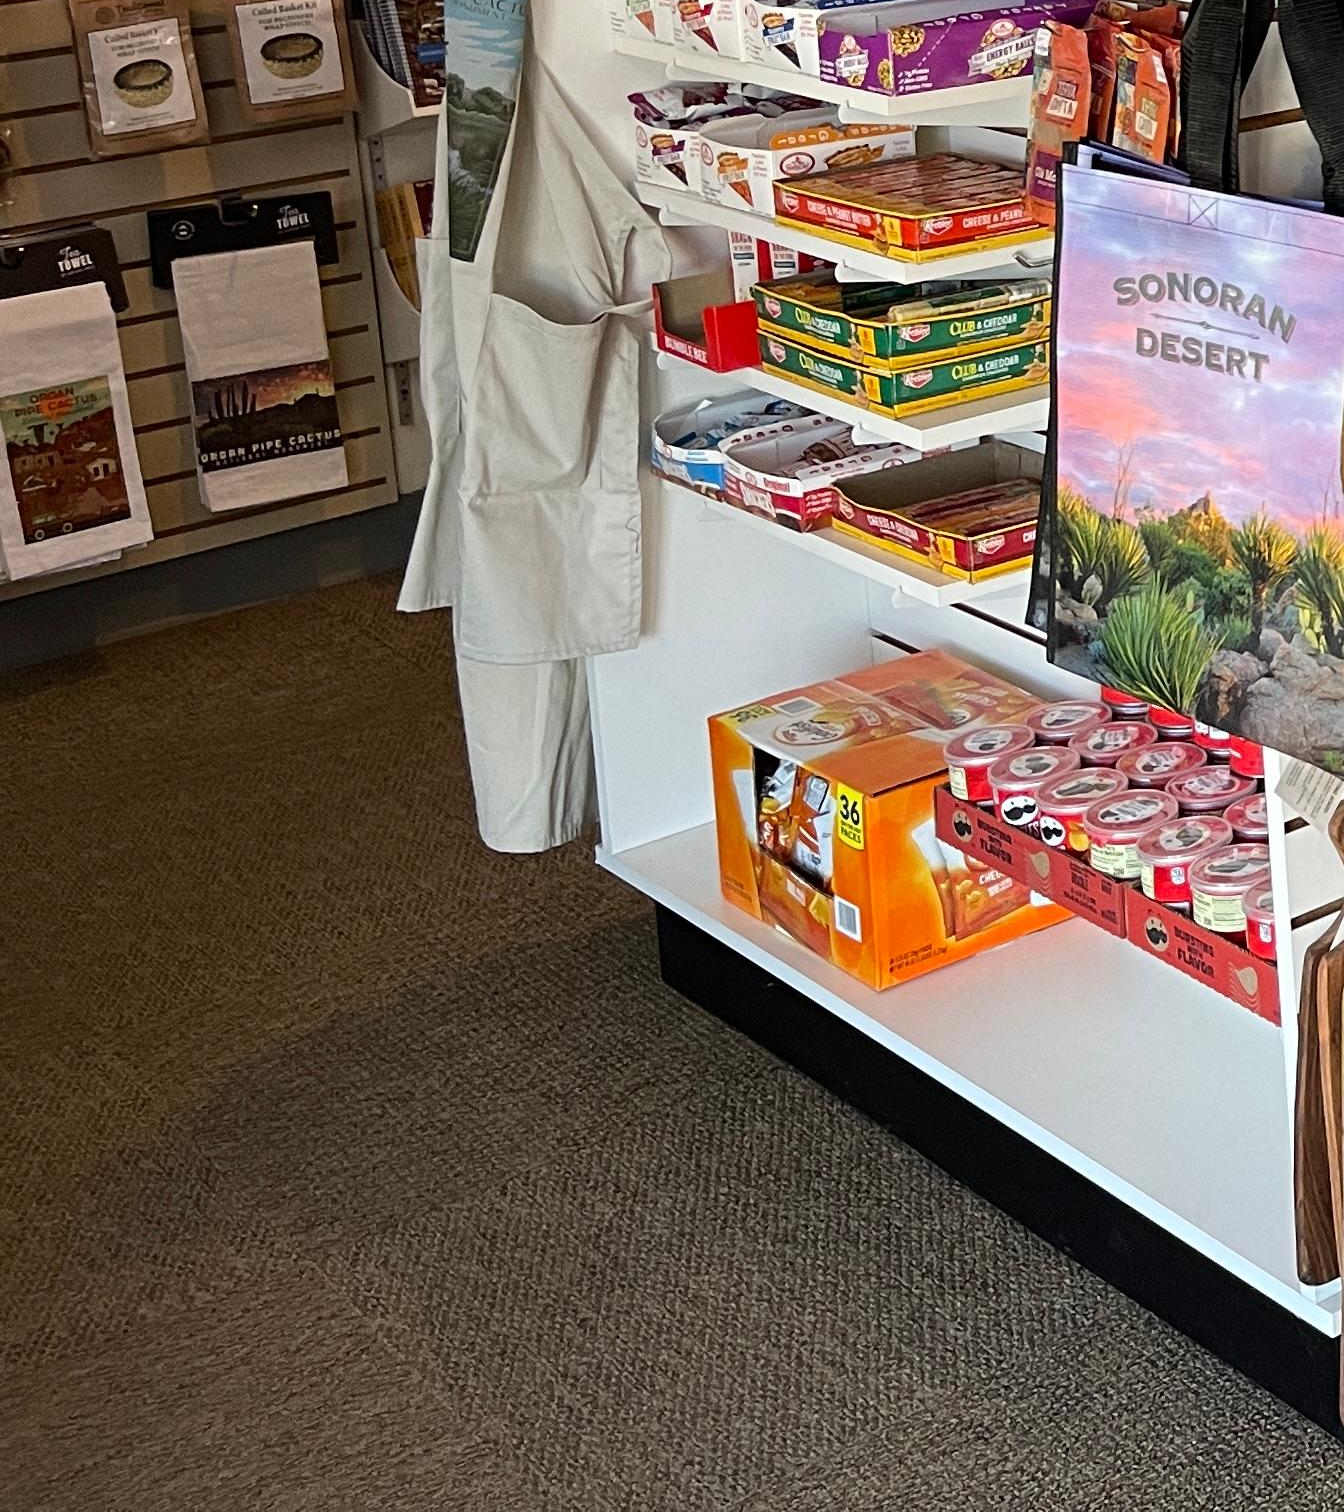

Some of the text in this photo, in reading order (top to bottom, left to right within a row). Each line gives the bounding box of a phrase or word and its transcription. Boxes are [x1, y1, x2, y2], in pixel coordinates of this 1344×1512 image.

[986, 44, 1013, 62] ENERGY
[276, 212, 310, 230] TOWEL
[962, 213, 991, 229] CHEESE
[57, 253, 94, 273] TOWEL
[59, 246, 82, 259] Tea
[1113, 271, 1297, 344] SONORAN
[950, 320, 976, 336] CLUB
[982, 313, 1018, 329] CHEDDAR
[693, 348, 707, 364] BEE
[1135, 327, 1270, 383] DESERT
[951, 363, 977, 380] CLUB
[984, 355, 1019, 371] CHEDDAR
[14, 393, 98, 418] PIPE CACTUS
[29, 388, 75, 404] ORGAN
[200, 429, 342, 464] ORGAN PIPE CACTUS
[840, 794, 861, 826] 36
[841, 826, 862, 844] PACKS
[980, 840, 1013, 865] FLAVOR
[1174, 926, 1215, 958] BURSTING
[1177, 948, 1215, 979] FLAVOR
